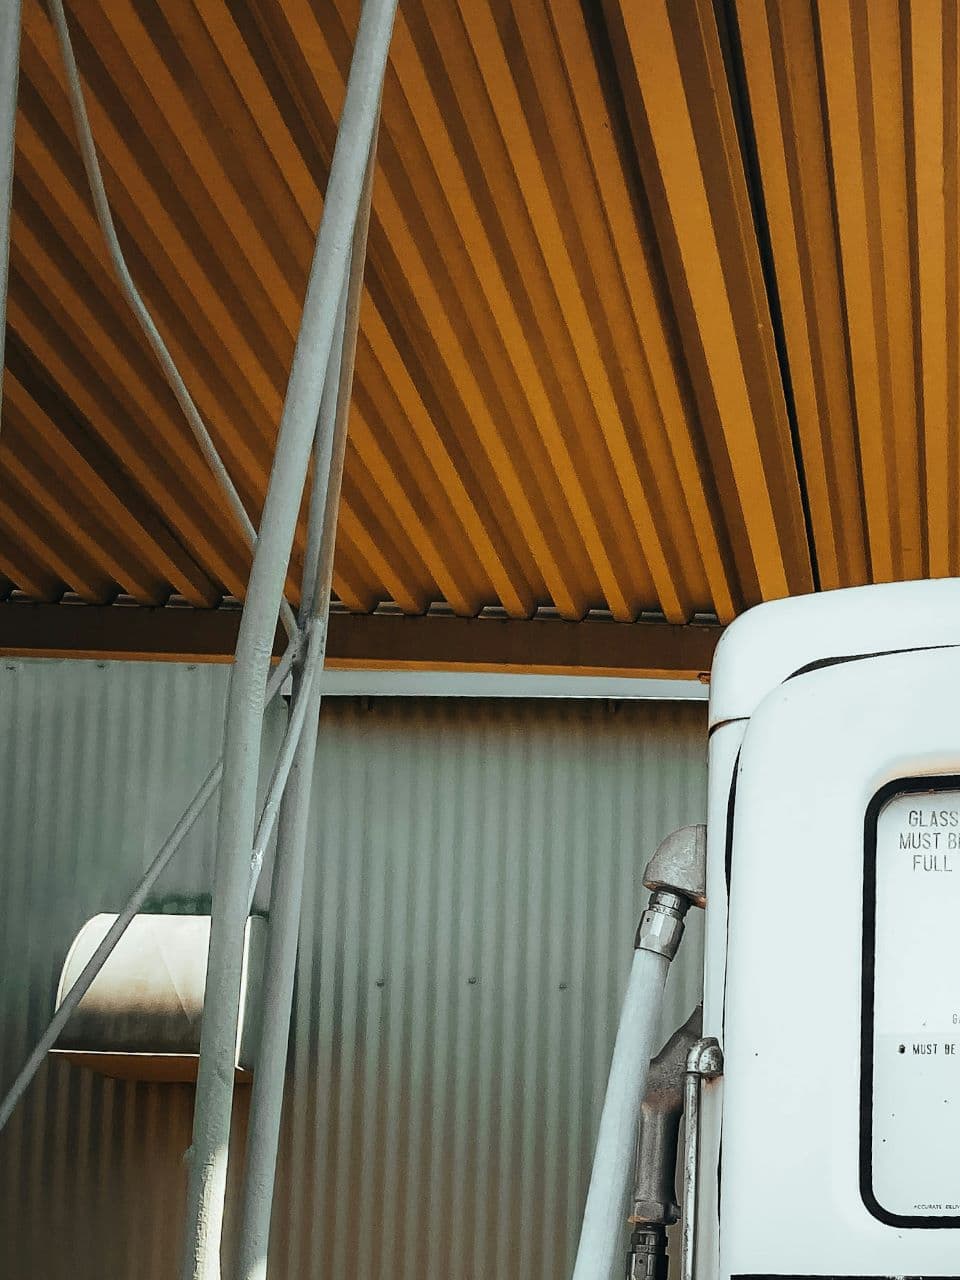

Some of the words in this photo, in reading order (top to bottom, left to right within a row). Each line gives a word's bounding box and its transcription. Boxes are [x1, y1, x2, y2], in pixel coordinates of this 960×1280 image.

[908, 810, 959, 827] GLASS
[899, 832, 941, 849] MUST
[913, 854, 953, 872] FULL
[912, 1044, 938, 1056] MUST
[944, 1044, 956, 1056] BE
